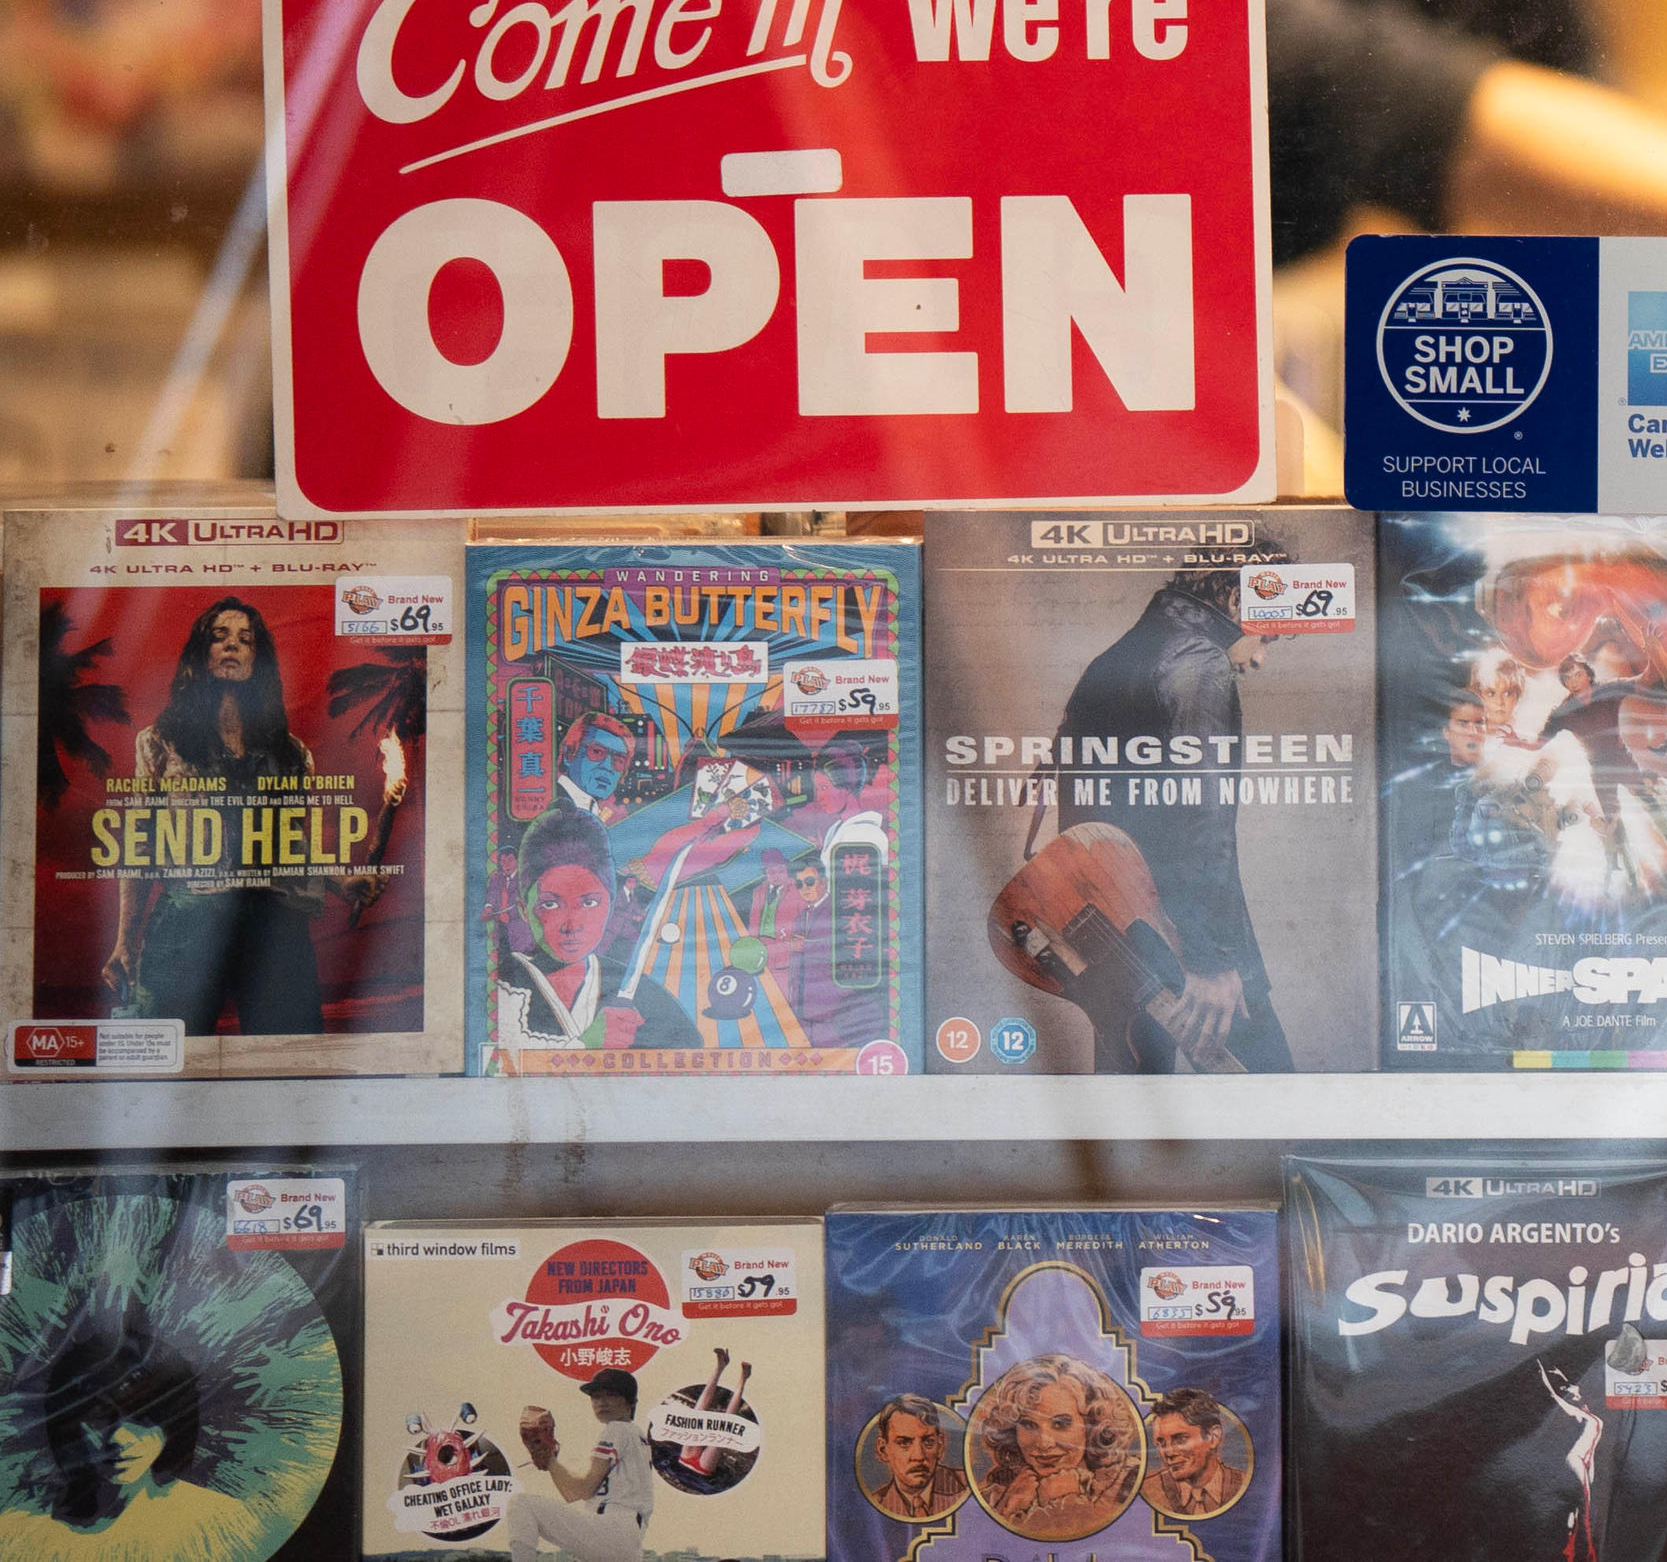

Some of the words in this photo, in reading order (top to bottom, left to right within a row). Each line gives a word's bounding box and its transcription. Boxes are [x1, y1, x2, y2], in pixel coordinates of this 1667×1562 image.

[357, 194, 1195, 426] OPEN
[1414, 335, 1514, 363] SHOP
[1404, 366, 1525, 395] SMALL
[1382, 456, 1477, 475] SUPPORT
[1482, 456, 1546, 475] LOCAL
[1401, 481, 1527, 499] BUSINESSES
[123, 522, 178, 543] 4K
[1040, 525, 1091, 544] 4K
[1007, 555, 1033, 564] 4K
[1043, 555, 1107, 564] ULTRA
[89, 565, 118, 574] 4K
[126, 565, 194, 574] ULTRA
[617, 570, 769, 582] WANDERING
[1293, 580, 1322, 589] Brand
[1326, 580, 1347, 588] New
[388, 595, 418, 604] Brand
[422, 595, 443, 604] New
[503, 585, 630, 662] GINZA
[646, 585, 881, 659] BUTTERFLY
[835, 676, 864, 684] Brand
[869, 675, 889, 683] New
[516, 686, 546, 793] 千葉真一
[945, 734, 1352, 764] SPRINGSTEEN
[106, 779, 155, 792] RACHEL
[258, 776, 298, 791] DYLAN
[303, 775, 354, 789] O'BRIEN
[947, 778, 1058, 806] DELIVER
[1074, 778, 1111, 806] ME
[1129, 778, 1201, 806] FROM
[1219, 776, 1352, 805] NOWHERE
[227, 796, 244, 805] EVIL
[247, 796, 267, 805] DEAD
[283, 796, 304, 805] DRAG
[307, 796, 319, 805] ME
[322, 796, 331, 805] TO
[334, 795, 353, 805] HELL
[91, 809, 222, 866] SEND
[242, 807, 368, 865] HELP
[381, 865, 404, 874] SWIFT
[840, 854, 873, 959] 梶芽衣子
[1535, 934, 1575, 945] STEVEN
[1579, 933, 1632, 945] SPIELBERG
[1562, 1016, 1571, 1027] A
[1575, 1015, 1593, 1027] JOE
[1597, 1015, 1632, 1027] DANTE
[1636, 1015, 1656, 1027] Film
[32, 1035, 58, 1050] MA
[66, 1037, 84, 1048] 15+
[947, 1030, 968, 1049] 12
[1003, 1031, 1024, 1050] 12
[603, 1052, 771, 1068] COLLECTION
[868, 1056, 892, 1074] 15
[1432, 1180, 1474, 1196] 4K
[281, 1194, 311, 1202] Brand
[315, 1194, 336, 1202] New
[1408, 1223, 1483, 1244] DARIO
[1490, 1223, 1620, 1244] ARGENTO's
[387, 1243, 419, 1256] third
[423, 1243, 477, 1256] window
[481, 1243, 516, 1256] films
[895, 1242, 983, 1251] SUTHERLAND
[998, 1241, 1041, 1250] BLACK
[1056, 1241, 1123, 1250] MEREDITH
[1139, 1241, 1210, 1250] ATHERTON
[548, 1262, 575, 1276] NEW
[580, 1261, 648, 1275] DIRECTORS
[735, 1261, 764, 1270] Brand
[767, 1260, 788, 1268] New
[559, 1279, 593, 1294] FROM
[598, 1279, 636, 1293] JAPAN
[1192, 1281, 1222, 1289] Brand
[1225, 1281, 1246, 1289] New
[501, 1302, 610, 1343] Takashi
[618, 1303, 682, 1345] Ono
[560, 1348, 632, 1366] 小野峻志
[665, 1414, 704, 1430] FASHION
[707, 1419, 746, 1437] RUNNER
[404, 1491, 448, 1507] CHEATING
[450, 1481, 482, 1498] OFFICE
[485, 1480, 513, 1493] LADY:
[434, 1504, 454, 1517] WET
[455, 1494, 491, 1512] GALAXY
